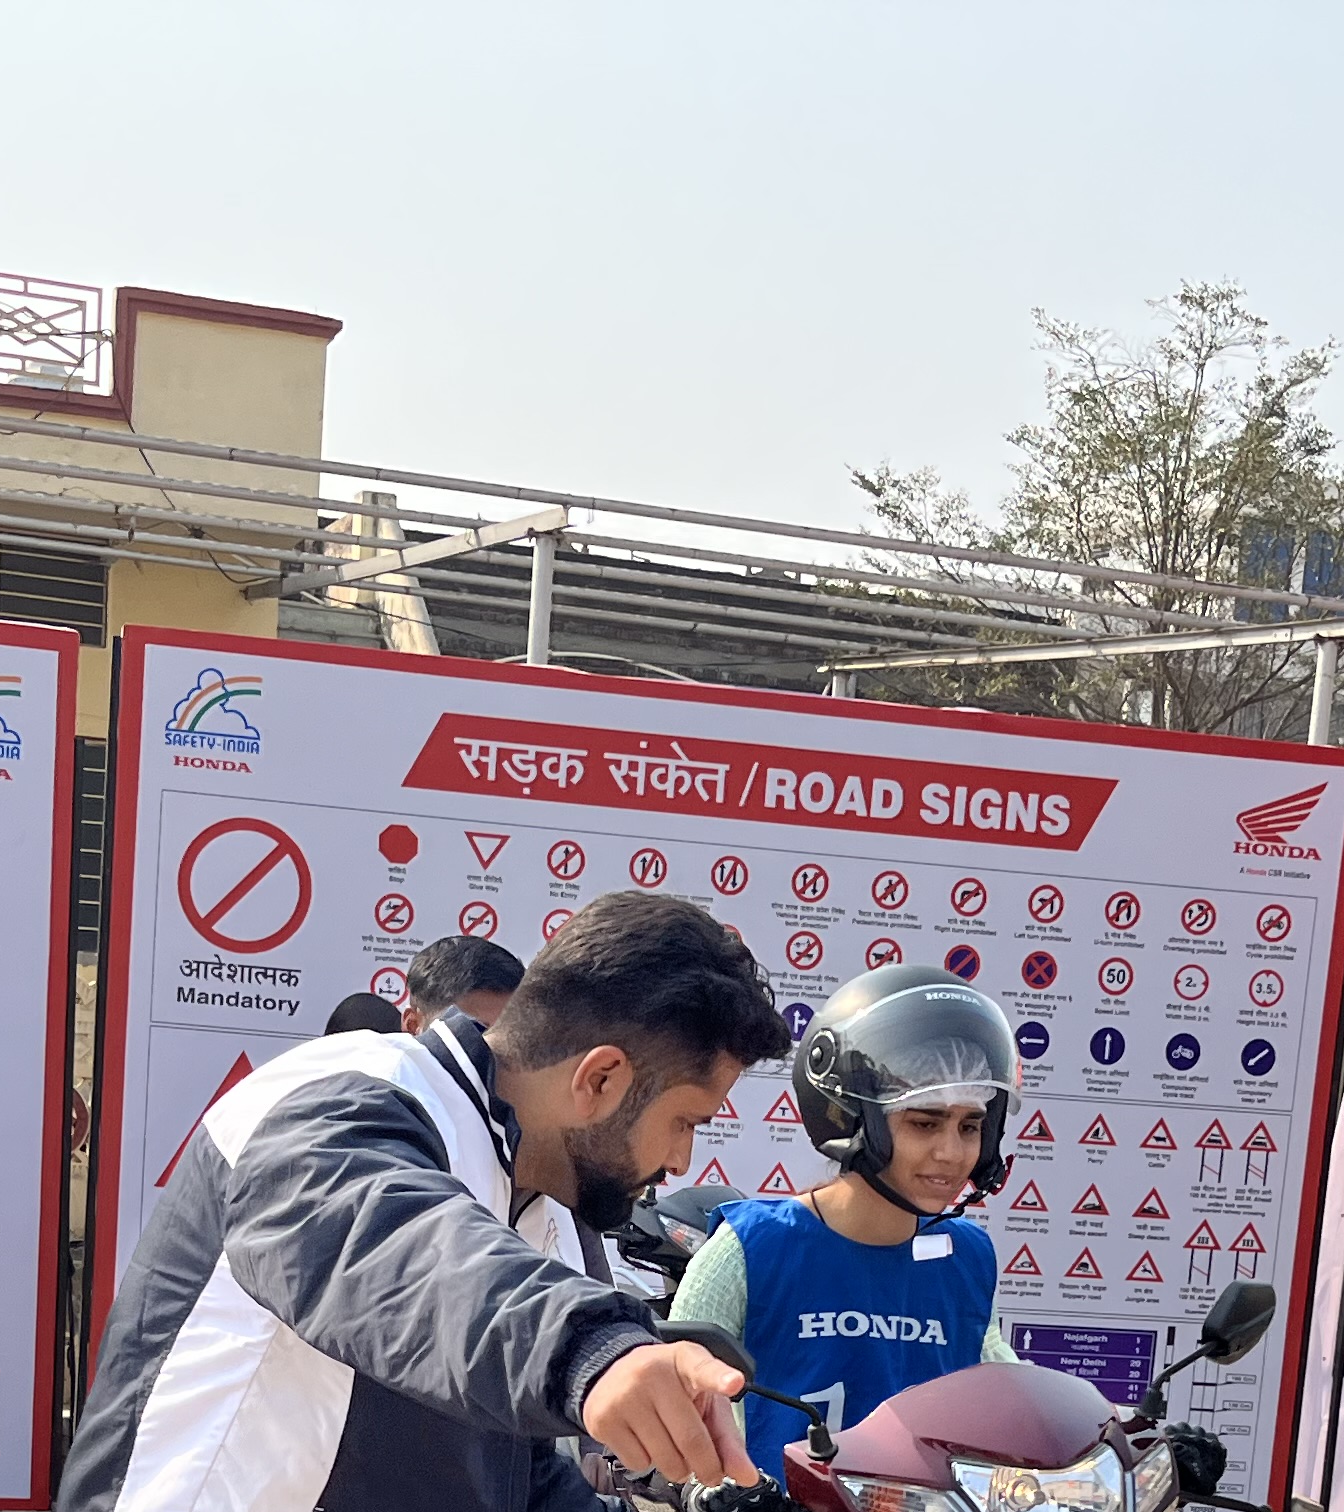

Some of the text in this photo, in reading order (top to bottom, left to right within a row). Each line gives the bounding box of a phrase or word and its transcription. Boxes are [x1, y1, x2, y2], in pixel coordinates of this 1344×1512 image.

[164, 733, 260, 755] SAFETY-INDIA
[173, 755, 253, 774] HONDA
[453, 737, 588, 795] सड़क
[603, 740, 731, 804] संकेत
[763, 768, 904, 820] ROAD
[919, 782, 1071, 836] SIGNS
[1232, 841, 1323, 861] HONDA
[179, 953, 302, 989] आदेशात्मक
[1105, 968, 1126, 985] 50
[177, 986, 301, 1017] Mandatory
[925, 991, 982, 1007] HONDA
[798, 1310, 948, 1346] HONDA
[1063, 1332, 1109, 1344] Najafgarh
[1060, 1356, 1142, 1368] New Delhi 20
[1128, 1370, 1141, 1378] 20
[1127, 1383, 1139, 1392] 41
[1126, 1393, 1138, 1401] 41
